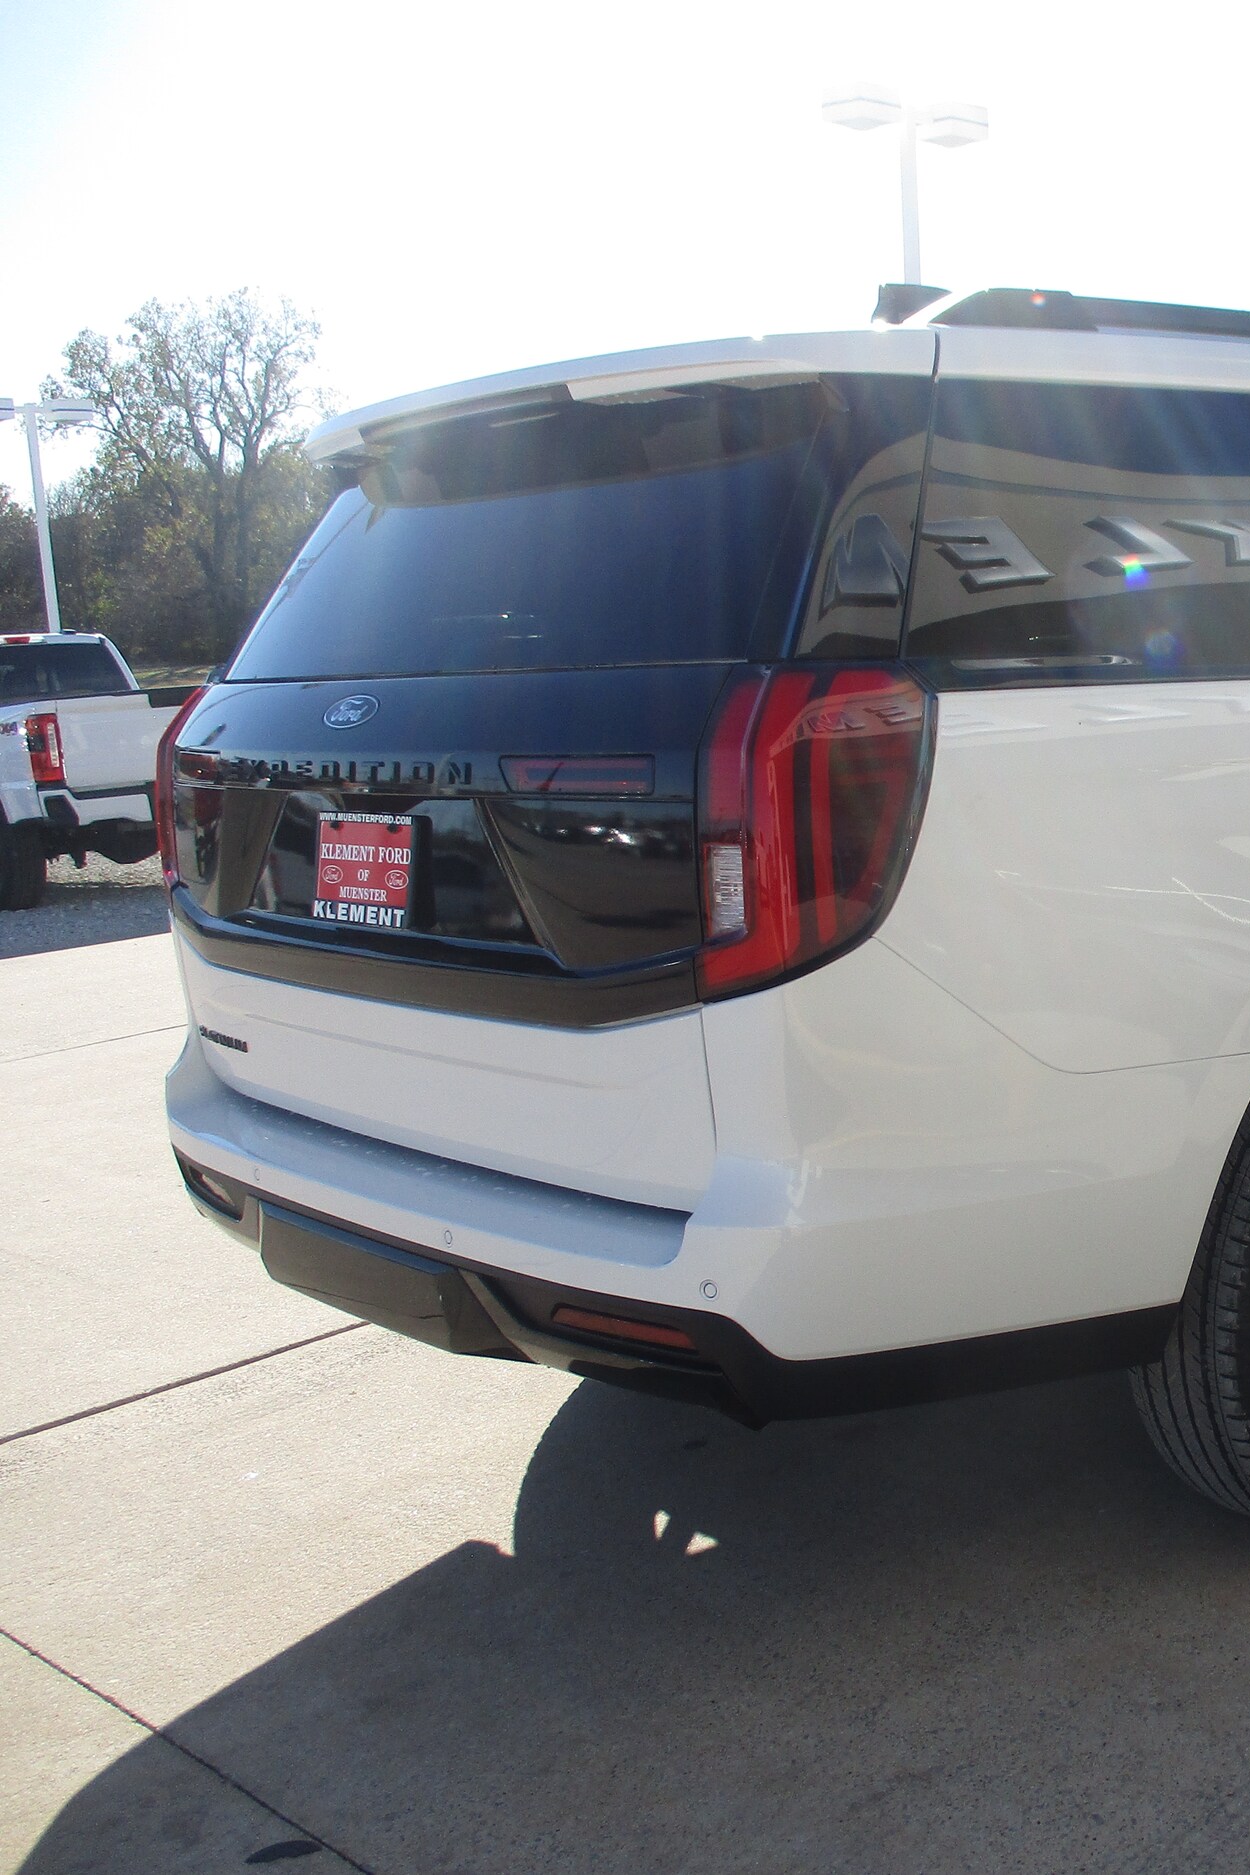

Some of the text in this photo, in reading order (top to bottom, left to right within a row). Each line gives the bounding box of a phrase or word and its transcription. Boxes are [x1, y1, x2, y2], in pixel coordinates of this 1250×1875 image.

[319, 812, 412, 825] WWW.MUENSTERFORD.COM
[321, 843, 412, 865] KLEMENT FORD
[357, 869, 370, 881] OF
[339, 886, 387, 902] MUENSTER
[313, 900, 405, 928] KLEMENT
